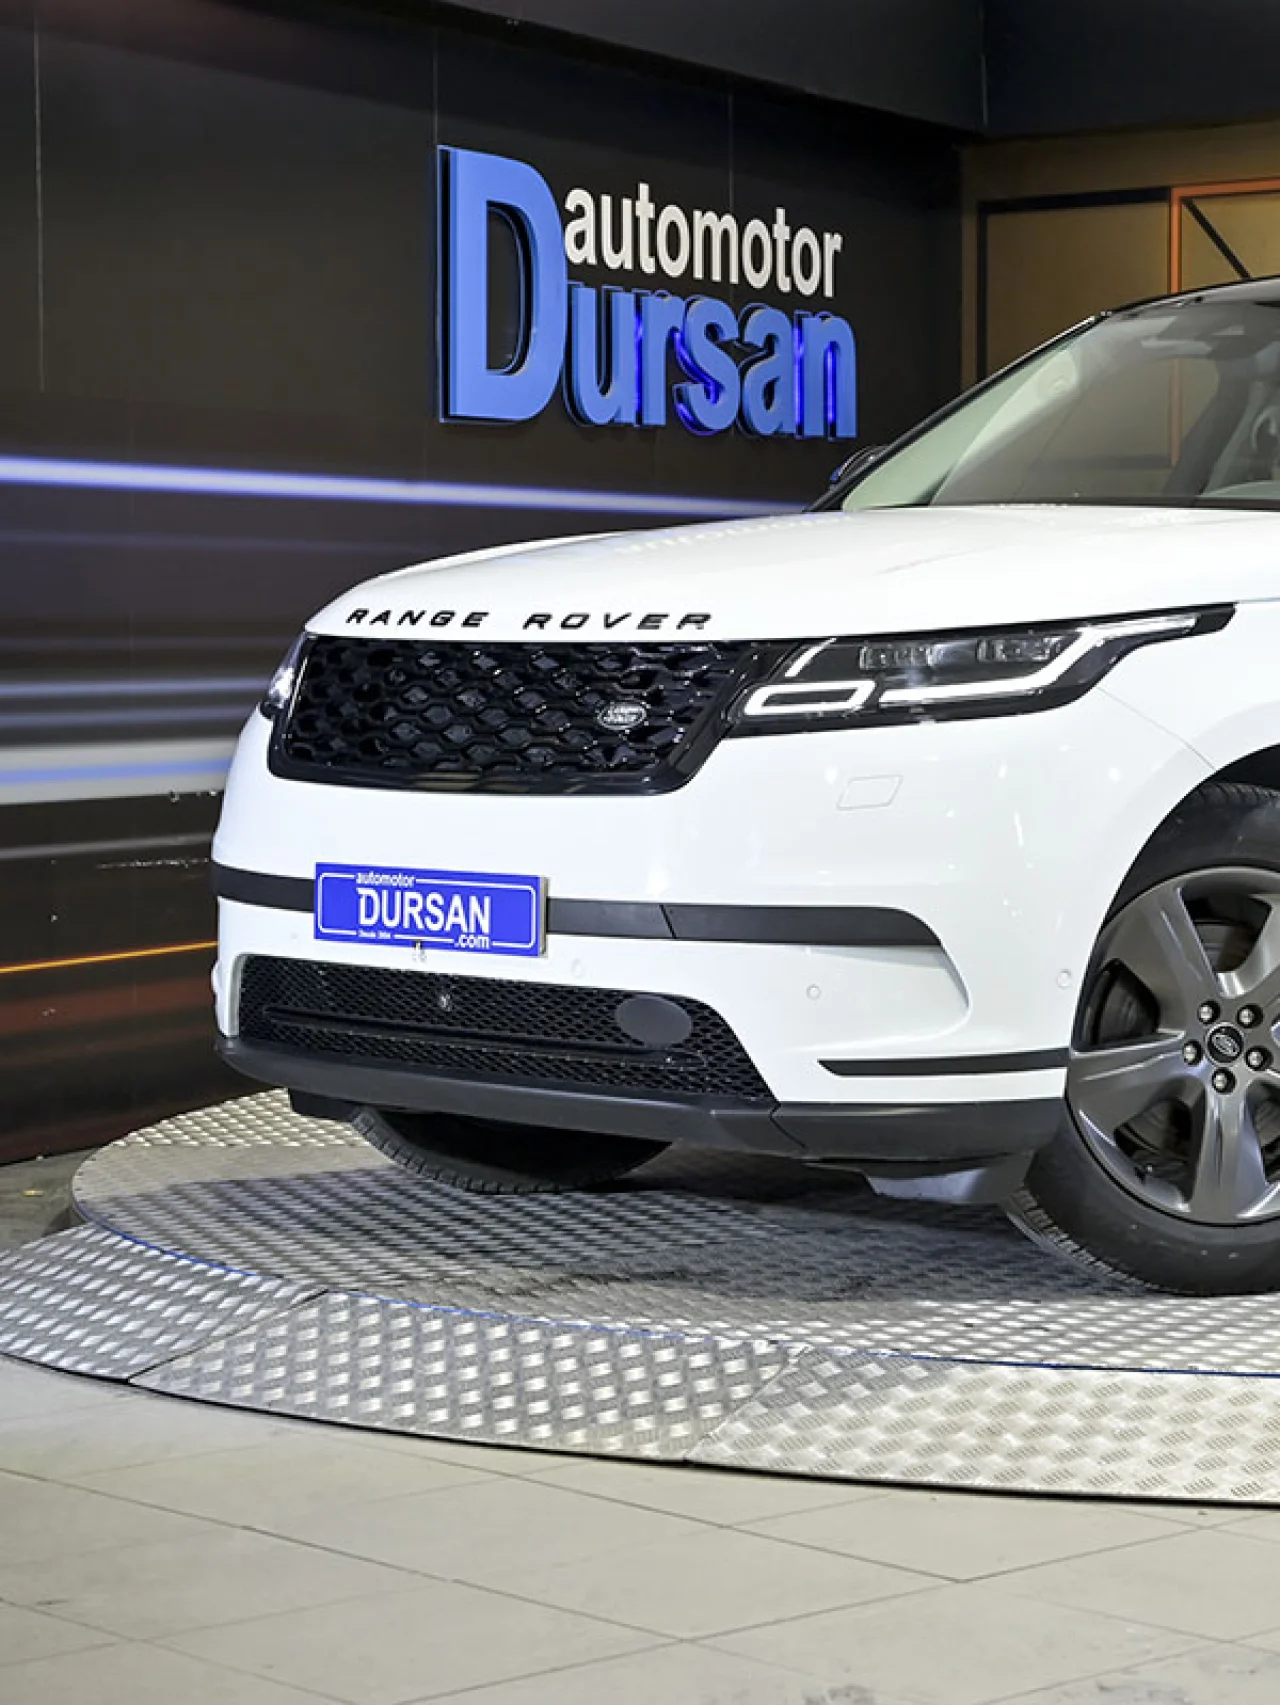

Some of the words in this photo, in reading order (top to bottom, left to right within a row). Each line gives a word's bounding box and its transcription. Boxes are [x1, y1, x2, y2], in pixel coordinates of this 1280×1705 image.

[564, 182, 842, 297] automotor
[437, 144, 857, 441] Dursan
[346, 608, 489, 628] RANGE
[522, 612, 711, 631] ROVER
[355, 871, 415, 888] automotor
[355, 887, 492, 935] DURSAN
[454, 934, 490, 950] .com
